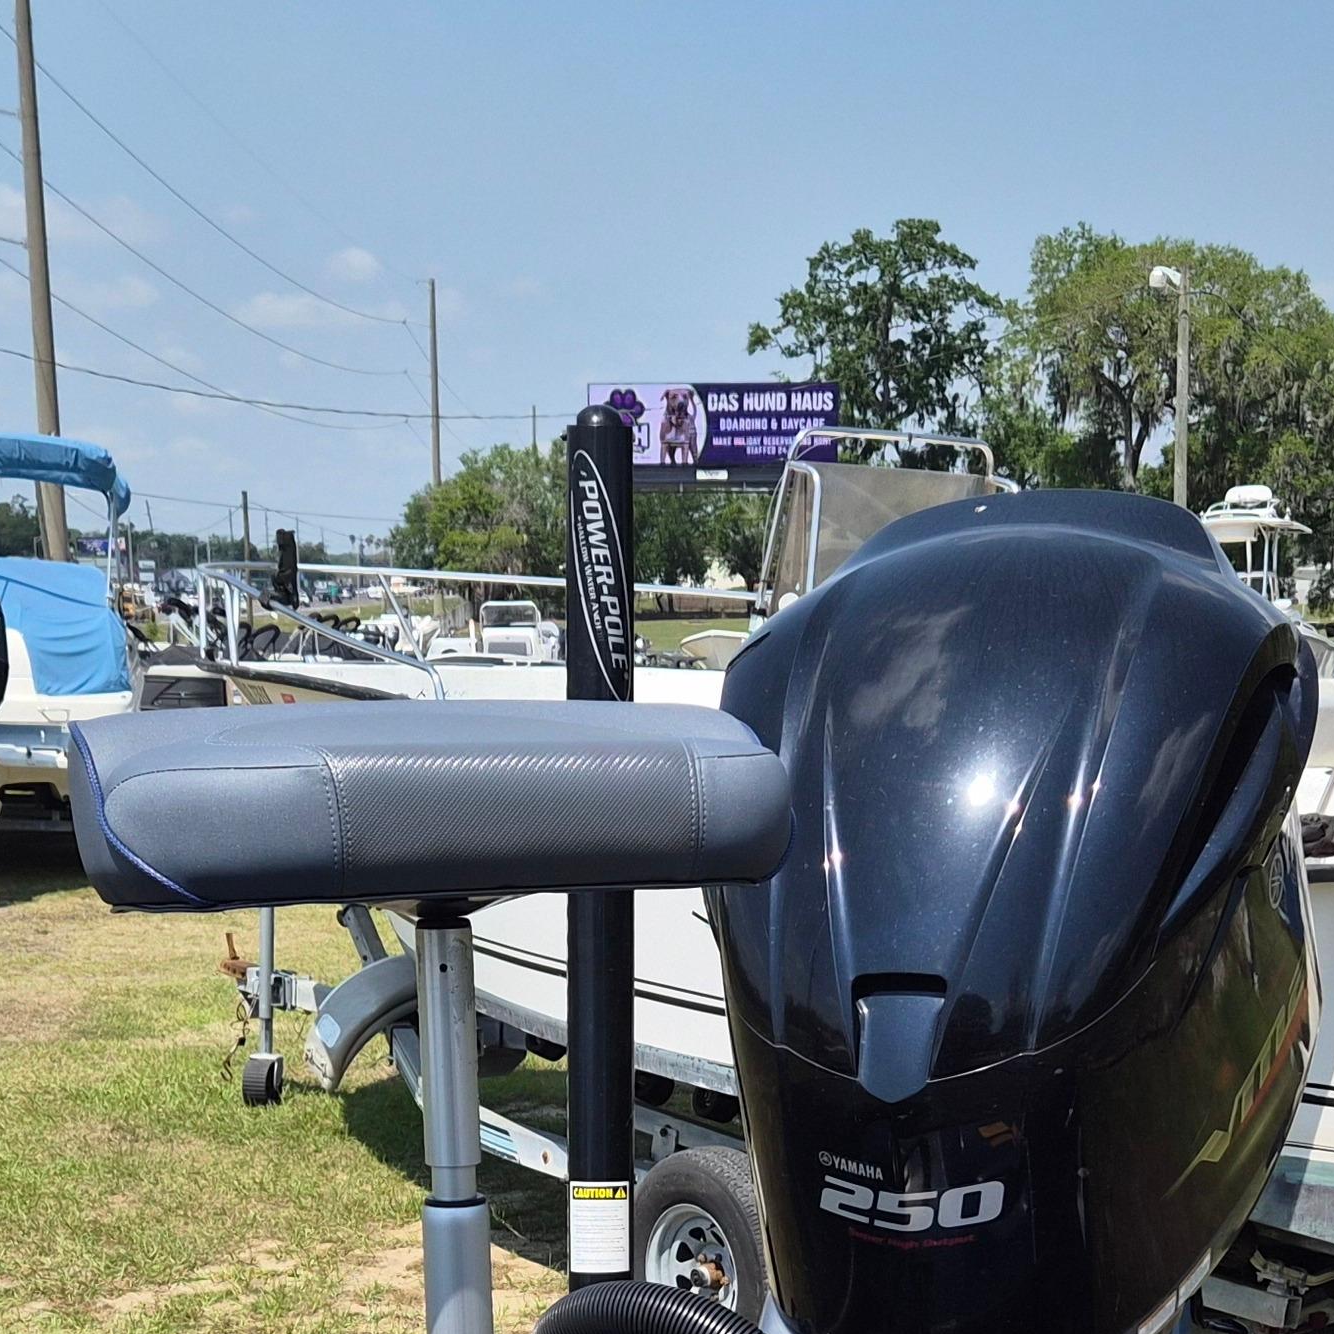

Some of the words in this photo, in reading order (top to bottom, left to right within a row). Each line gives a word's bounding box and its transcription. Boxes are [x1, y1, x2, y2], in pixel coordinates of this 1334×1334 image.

[707, 392, 739, 411] DAS
[743, 392, 787, 411] HUND
[791, 391, 834, 411] HAUS
[720, 417, 768, 431] BOARDING
[771, 418, 778, 430] &
[579, 479, 628, 670] POWER-POLE
[832, 1155, 884, 1181] YAMAHA
[573, 1187, 614, 1199] CAUTION
[819, 1174, 1005, 1232] 250
[922, 1234, 977, 1248] Output
